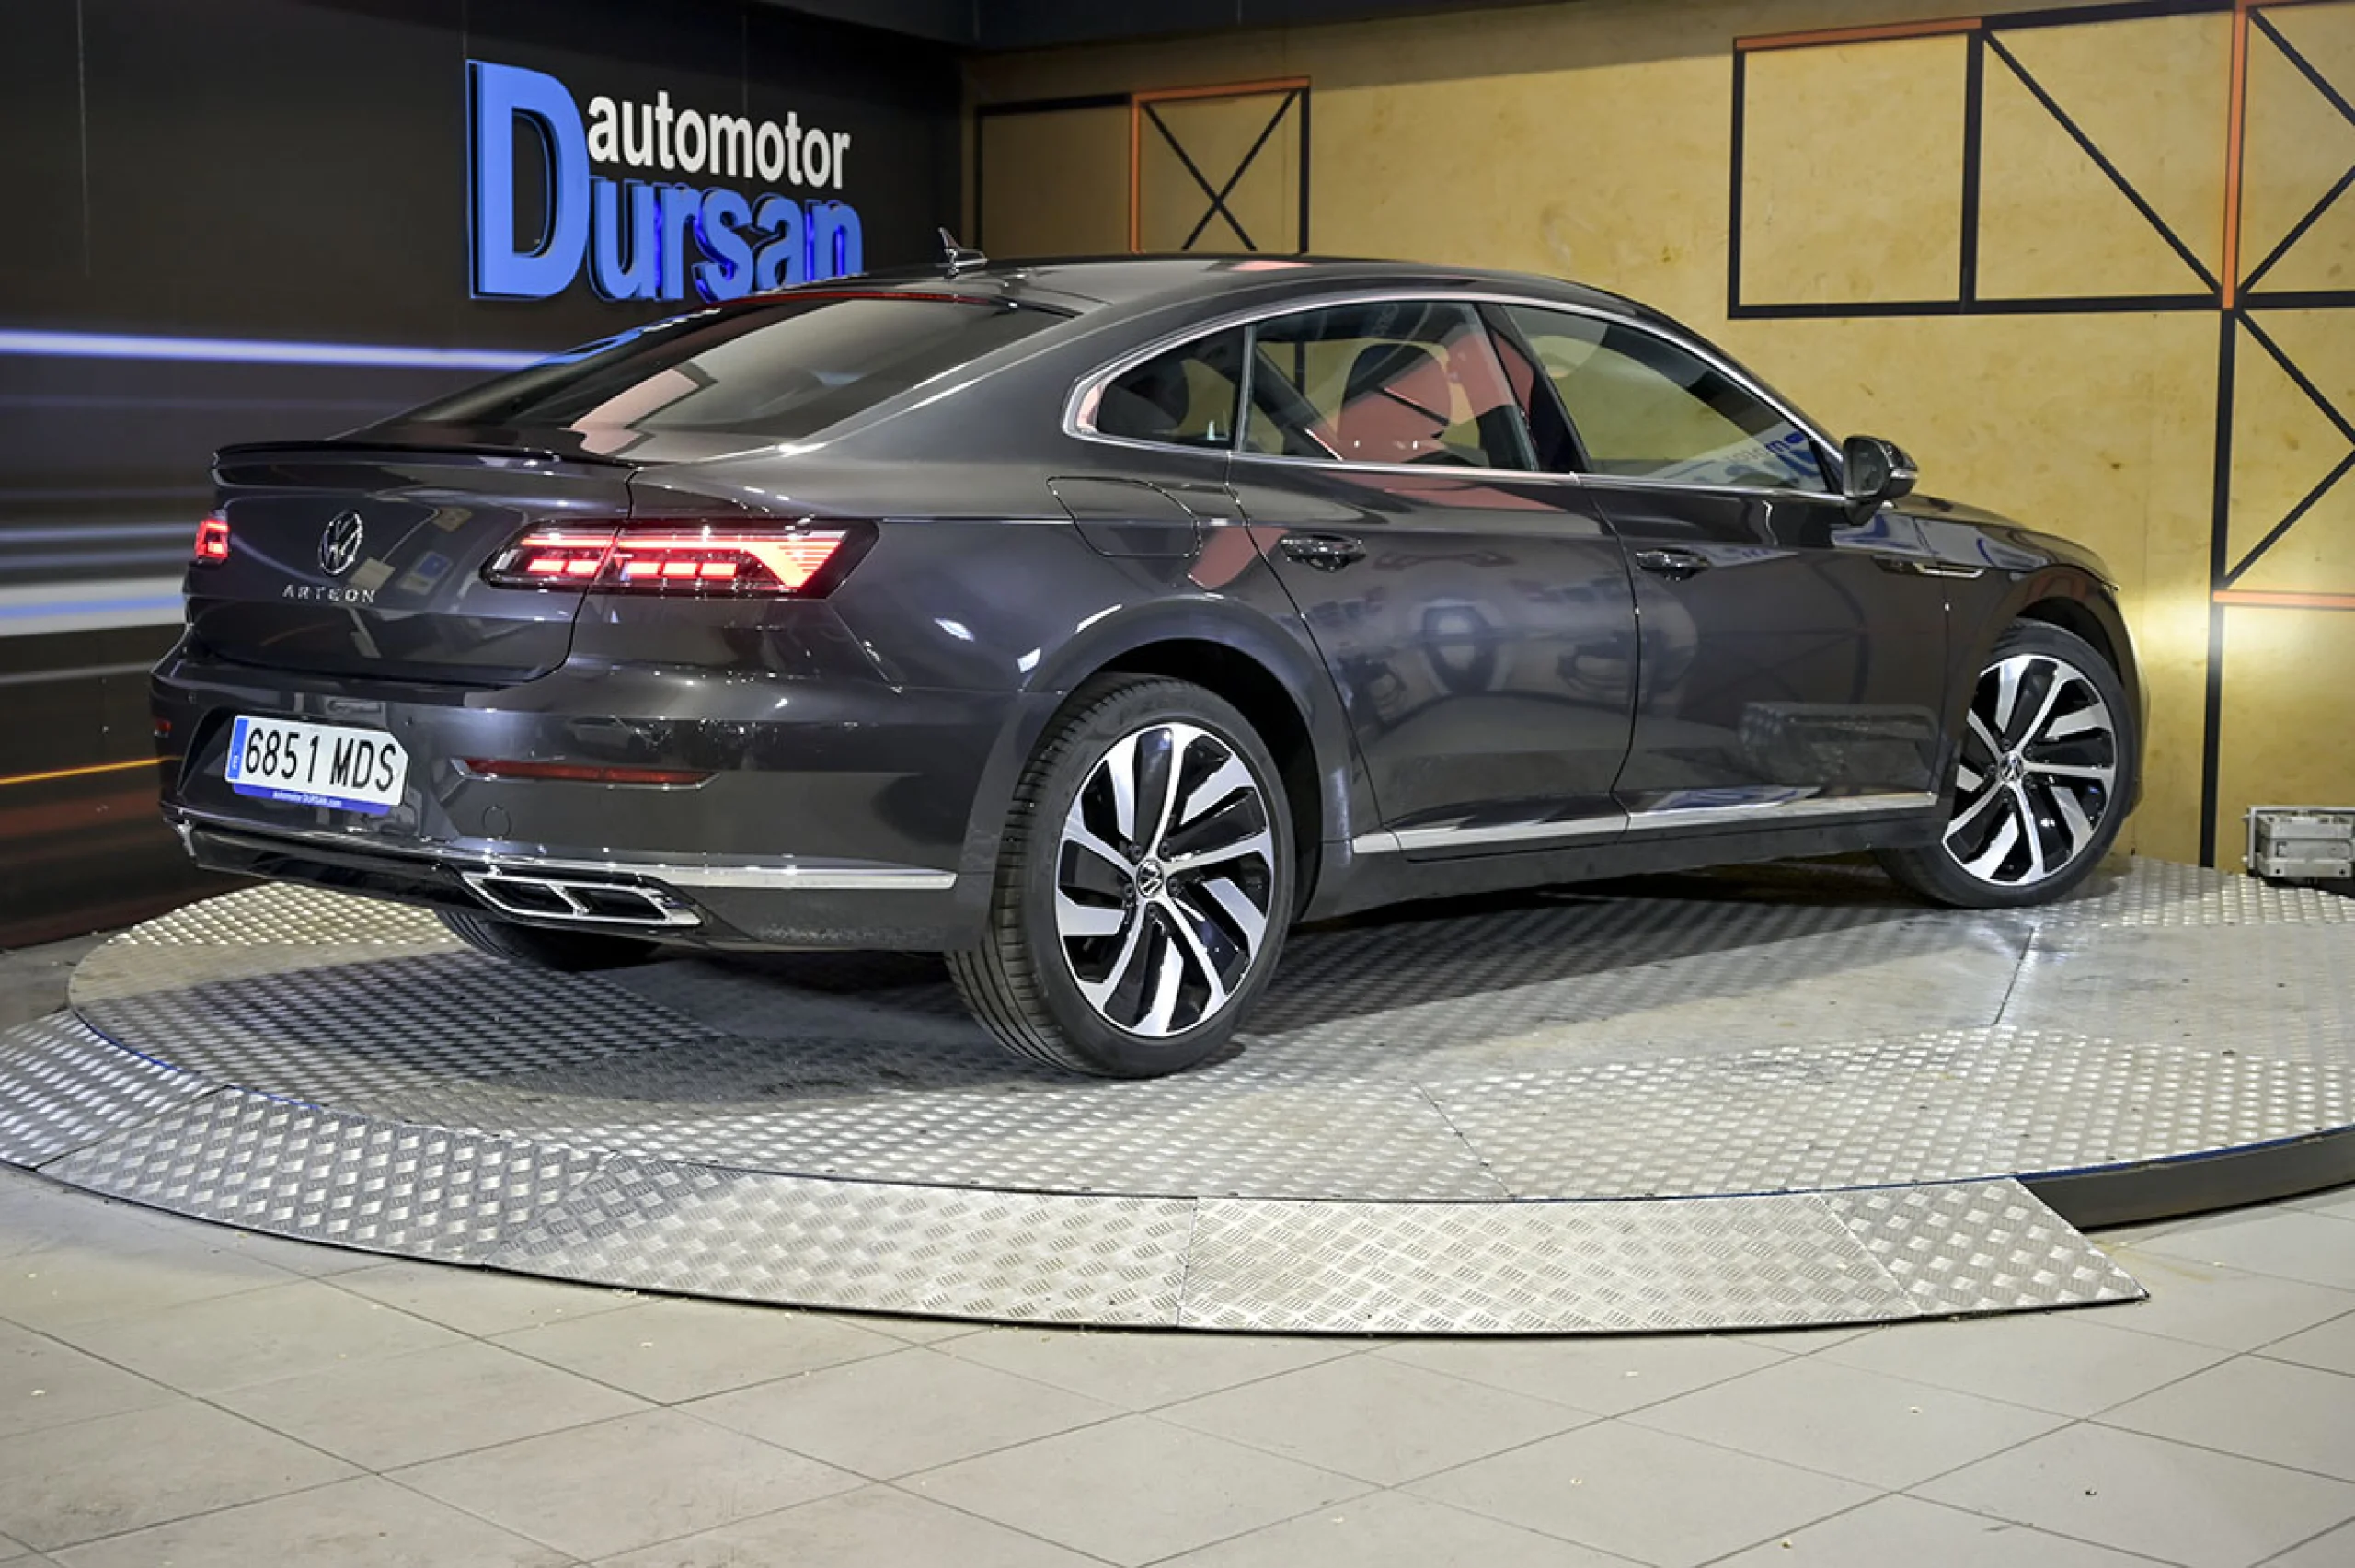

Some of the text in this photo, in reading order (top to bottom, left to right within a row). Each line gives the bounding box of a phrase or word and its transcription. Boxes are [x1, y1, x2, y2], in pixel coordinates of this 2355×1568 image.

[465, 58, 863, 303] Dursan
[587, 90, 851, 189] automotor
[281, 584, 376, 603] ARTEON
[245, 727, 397, 792] 6851 MDS
